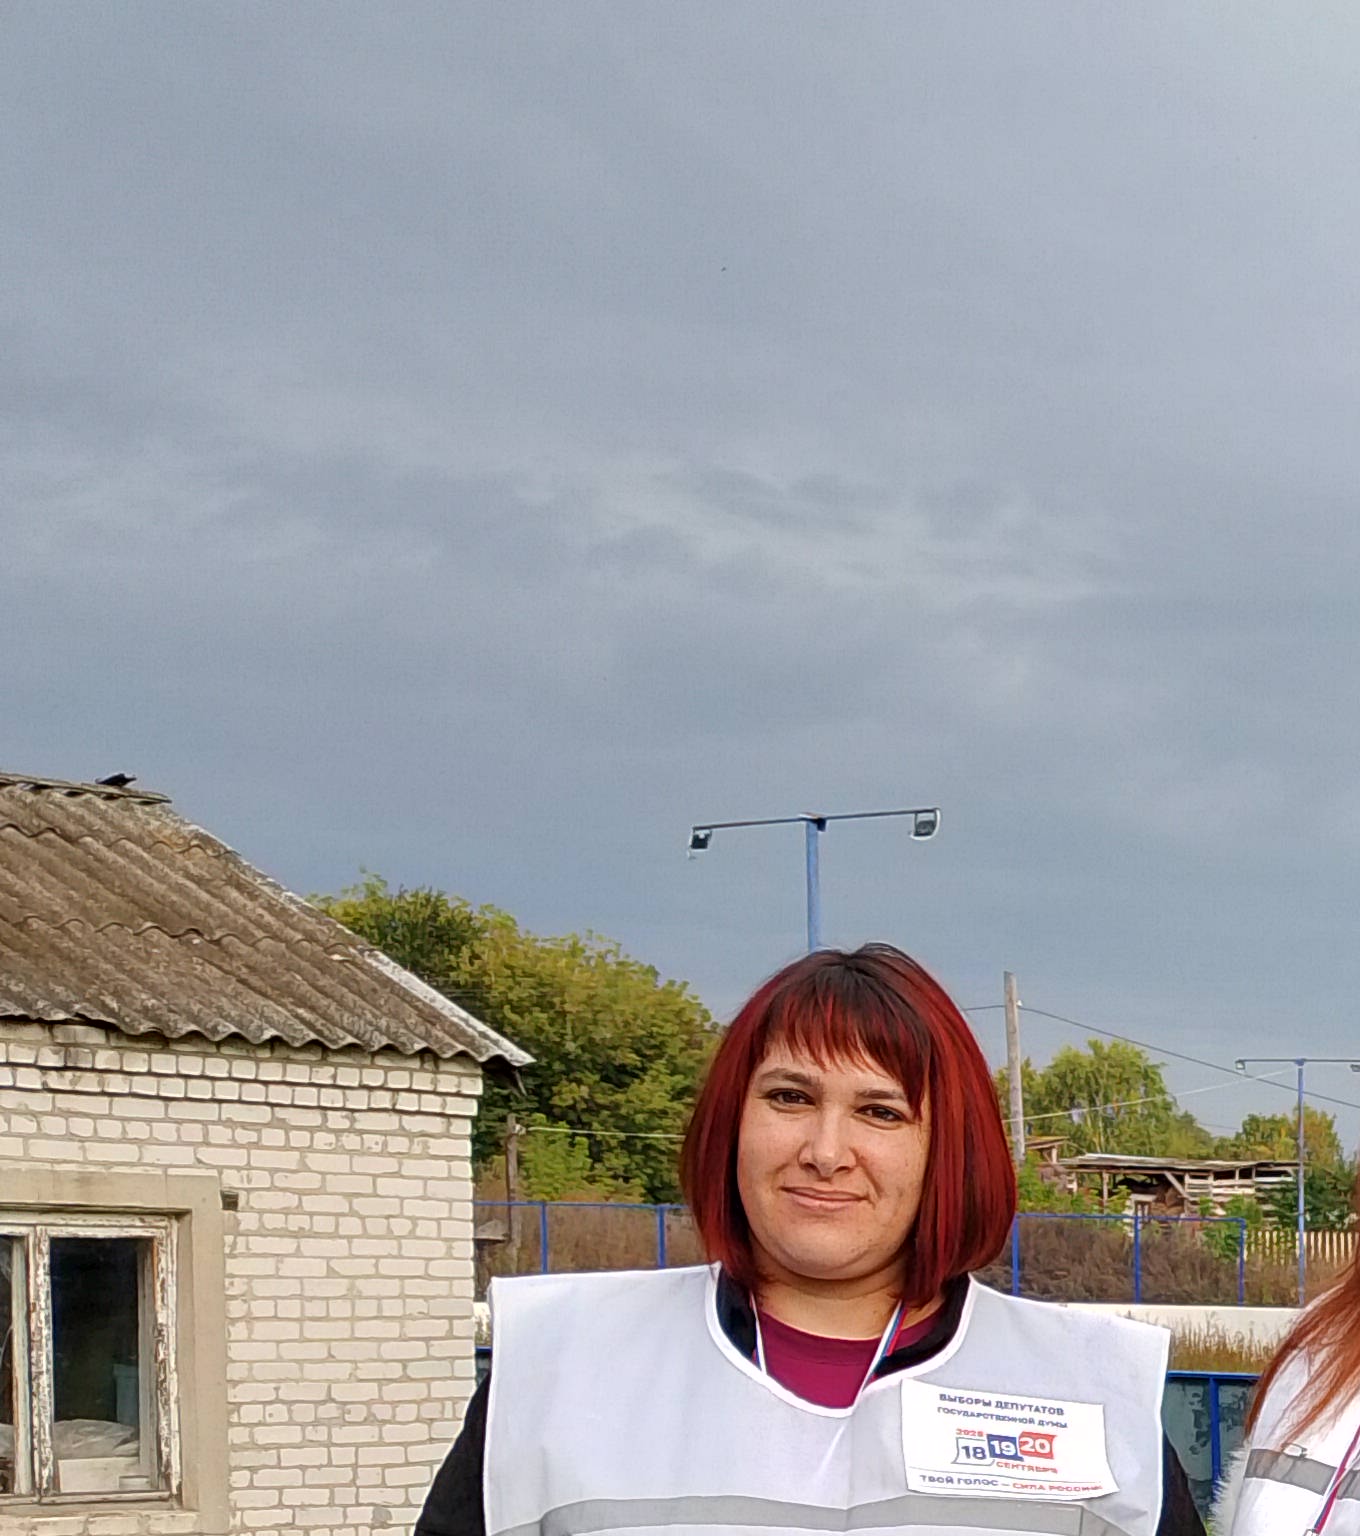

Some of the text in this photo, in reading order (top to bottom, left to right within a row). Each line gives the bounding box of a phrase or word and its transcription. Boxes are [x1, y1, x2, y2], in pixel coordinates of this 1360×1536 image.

[939, 1393, 1065, 1416] ВЫБОРЫ ДЕПУТАТОВ
[961, 1437, 1051, 1460] 18 19 20
[920, 1474, 954, 1485] ТВОЙ
[957, 1478, 998, 1487] ГОЛОС
